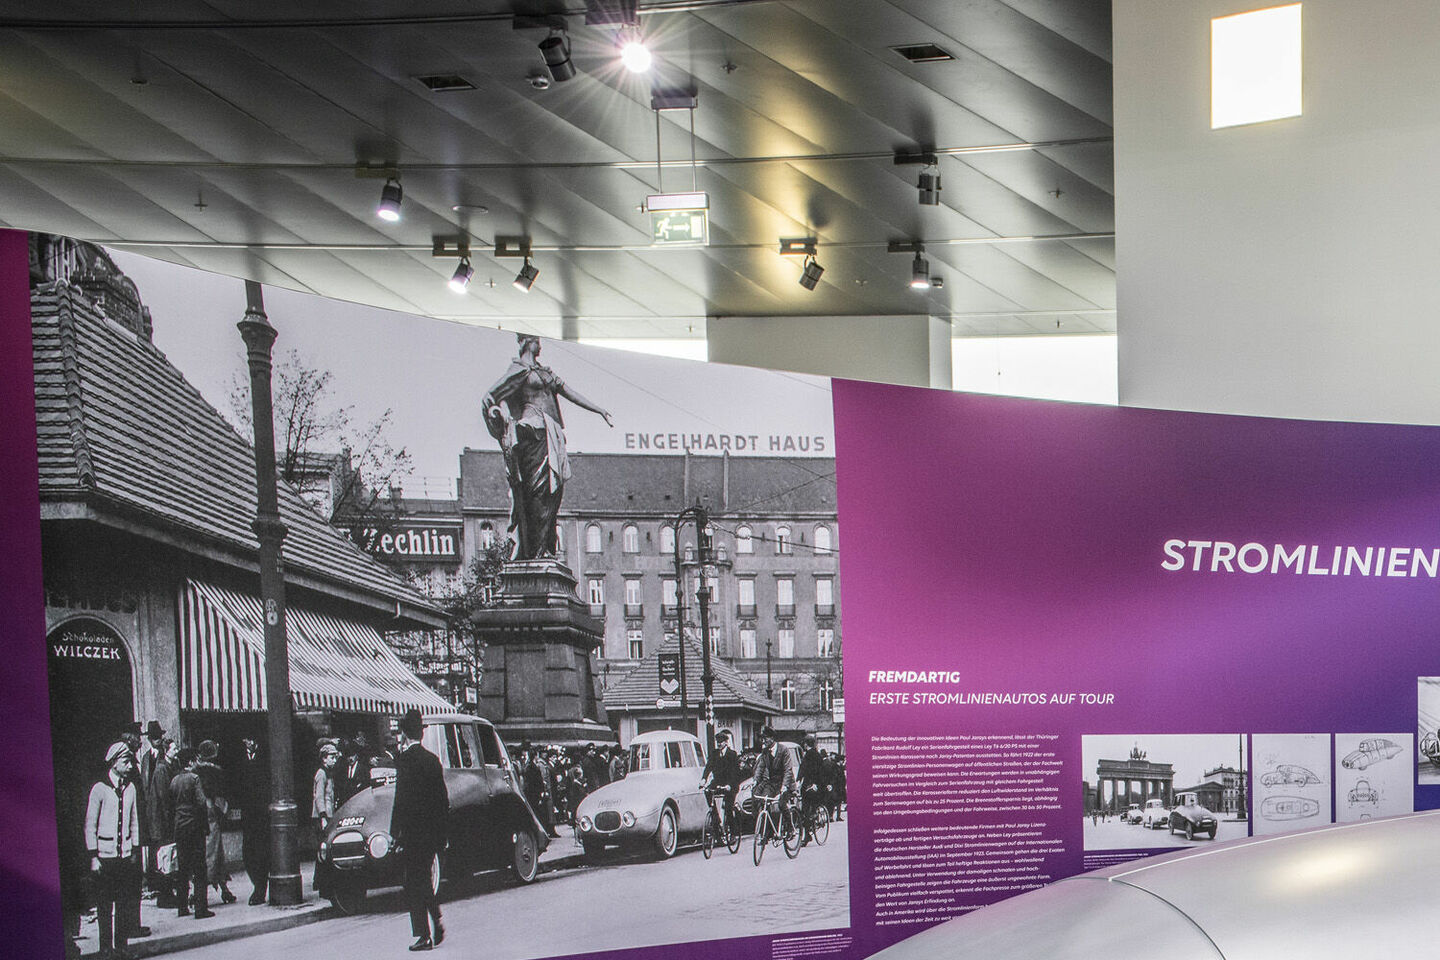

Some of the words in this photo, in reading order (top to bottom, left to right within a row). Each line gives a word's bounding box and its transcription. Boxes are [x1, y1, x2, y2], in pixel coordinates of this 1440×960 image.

[625, 433, 758, 451] ENGELHARDT
[769, 435, 825, 452] HAUS
[53, 645, 121, 660] WILCZEK
[868, 671, 961, 684] FREMDARTIG
[869, 692, 909, 705] ERSTE
[913, 692, 1047, 705] STROMLINIENAUTOS
[1049, 693, 1076, 705] AUF
[1079, 692, 1115, 705] TOUR
